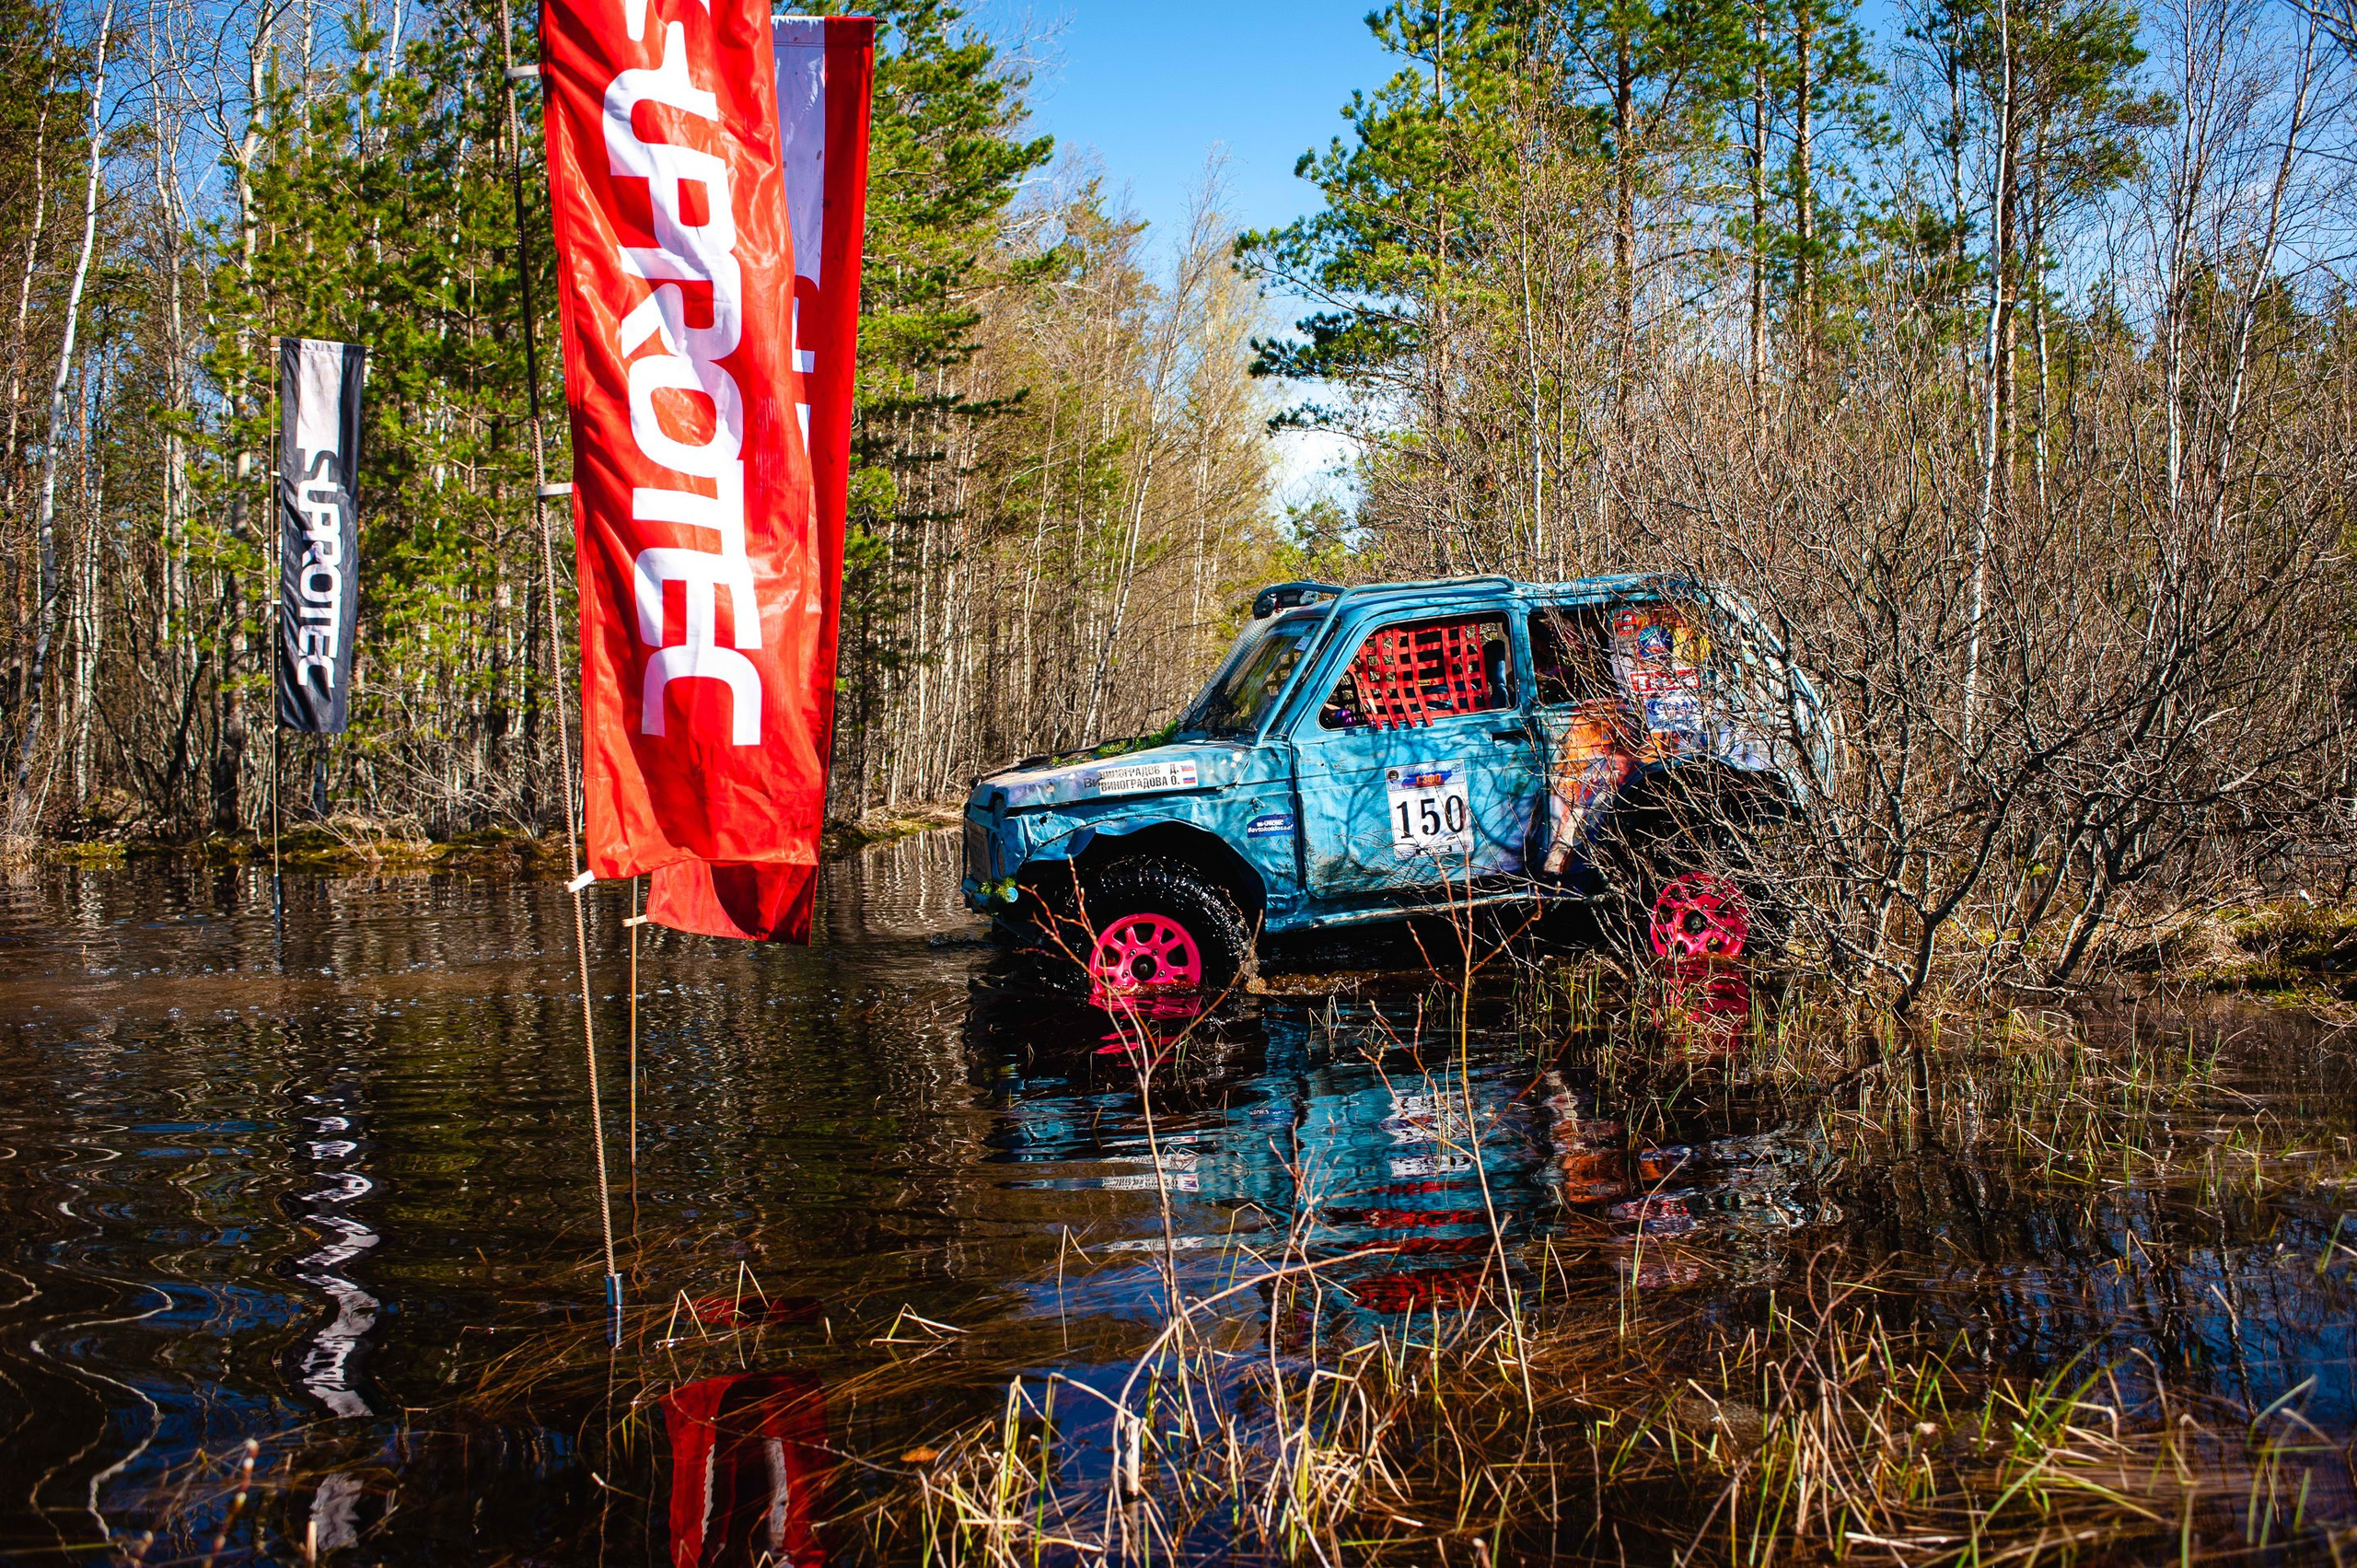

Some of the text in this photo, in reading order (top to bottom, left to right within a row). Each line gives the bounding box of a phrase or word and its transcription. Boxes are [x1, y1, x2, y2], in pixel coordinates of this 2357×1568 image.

[296, 449, 343, 689] SUPROTEC
[1100, 777, 1168, 792] ВИНОГРАДОВА
[1396, 795, 1466, 840] 150
